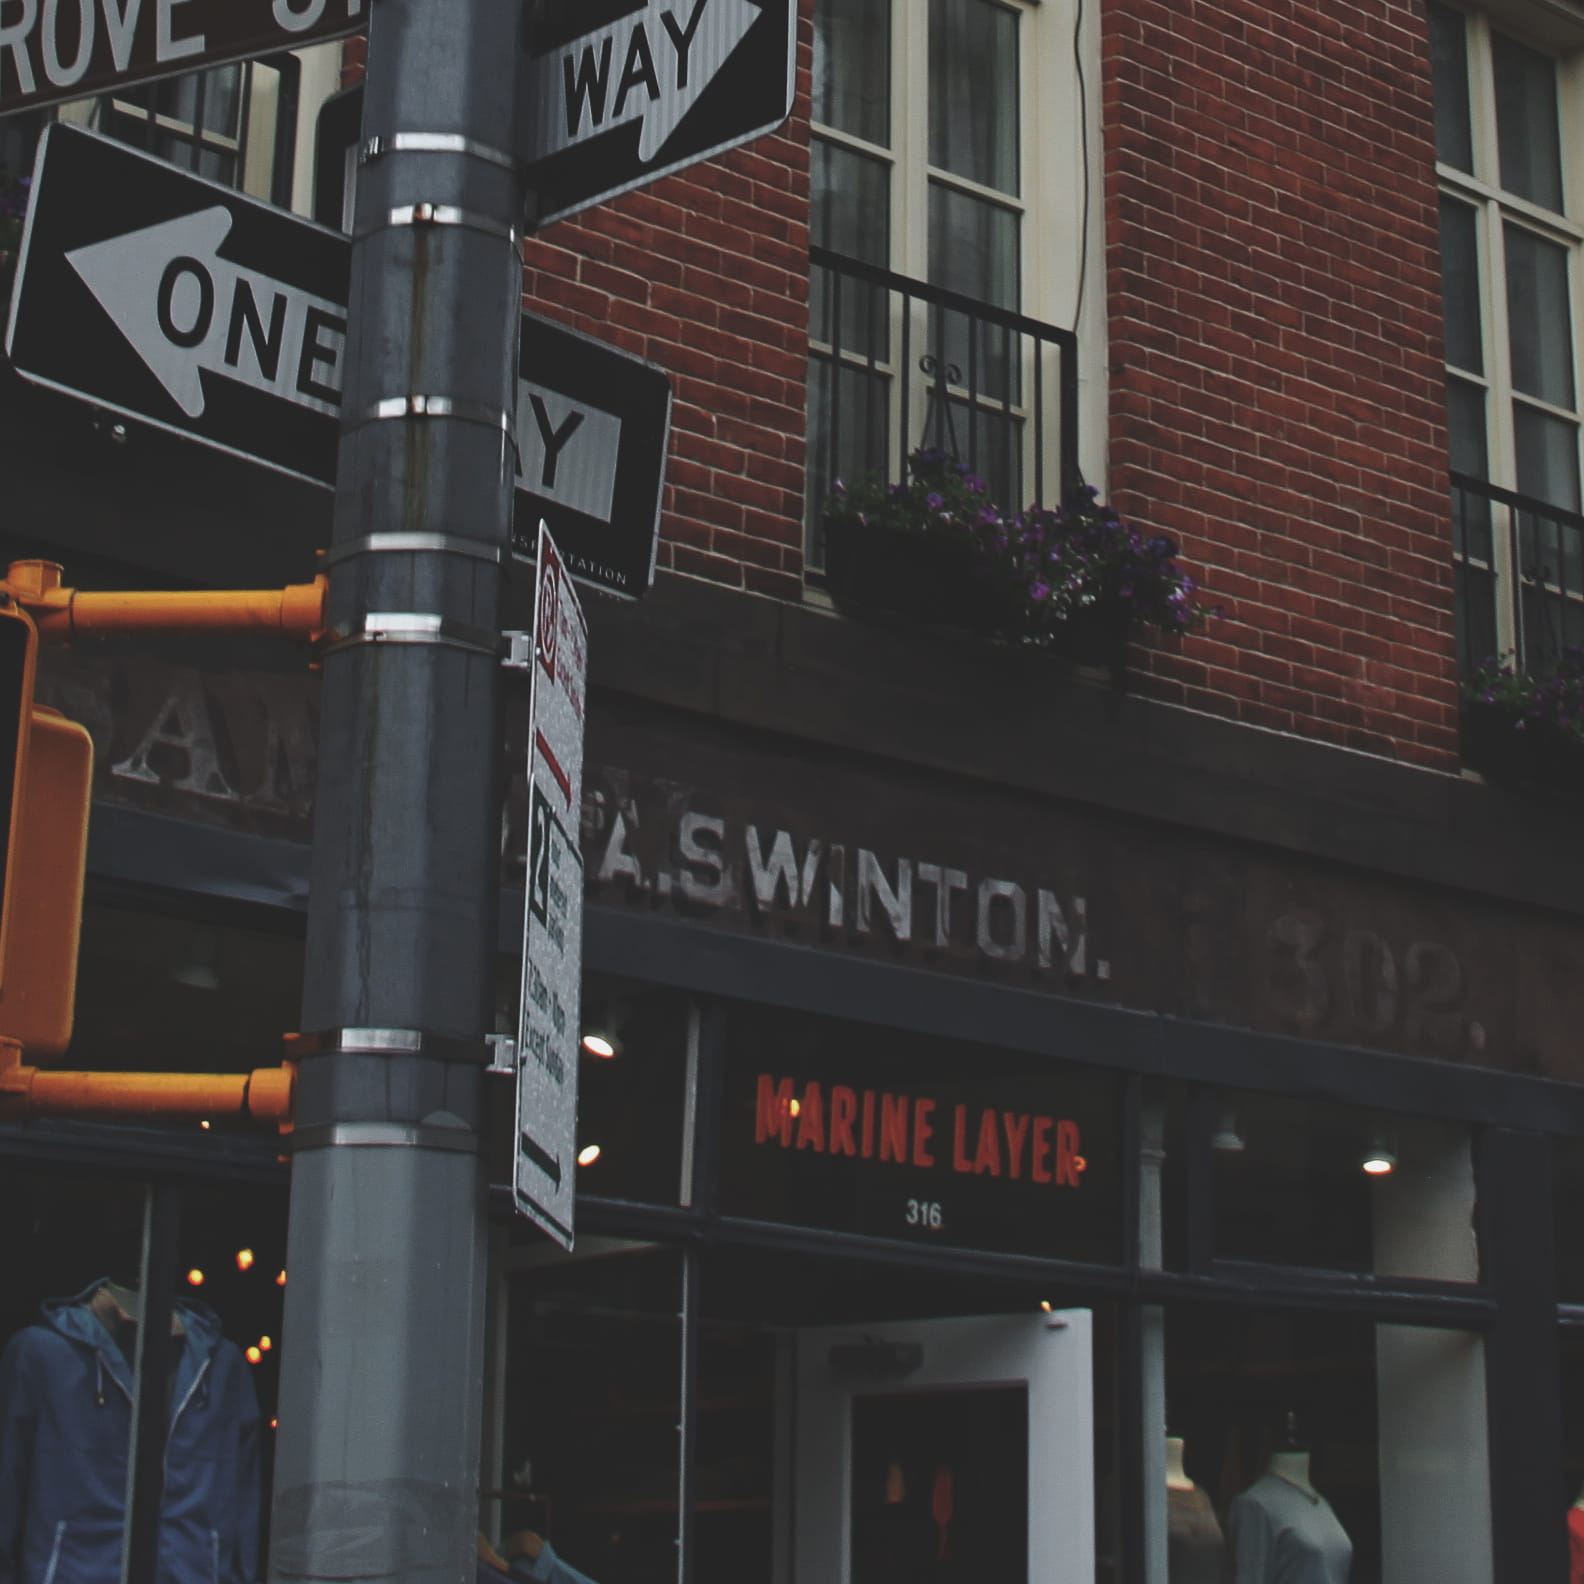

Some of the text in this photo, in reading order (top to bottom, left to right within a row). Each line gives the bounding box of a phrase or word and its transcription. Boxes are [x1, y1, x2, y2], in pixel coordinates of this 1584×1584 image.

[155, 254, 348, 405] ONE
[754, 1072, 1082, 1188] MARINE LAYER
[905, 1197, 943, 1228] 316
